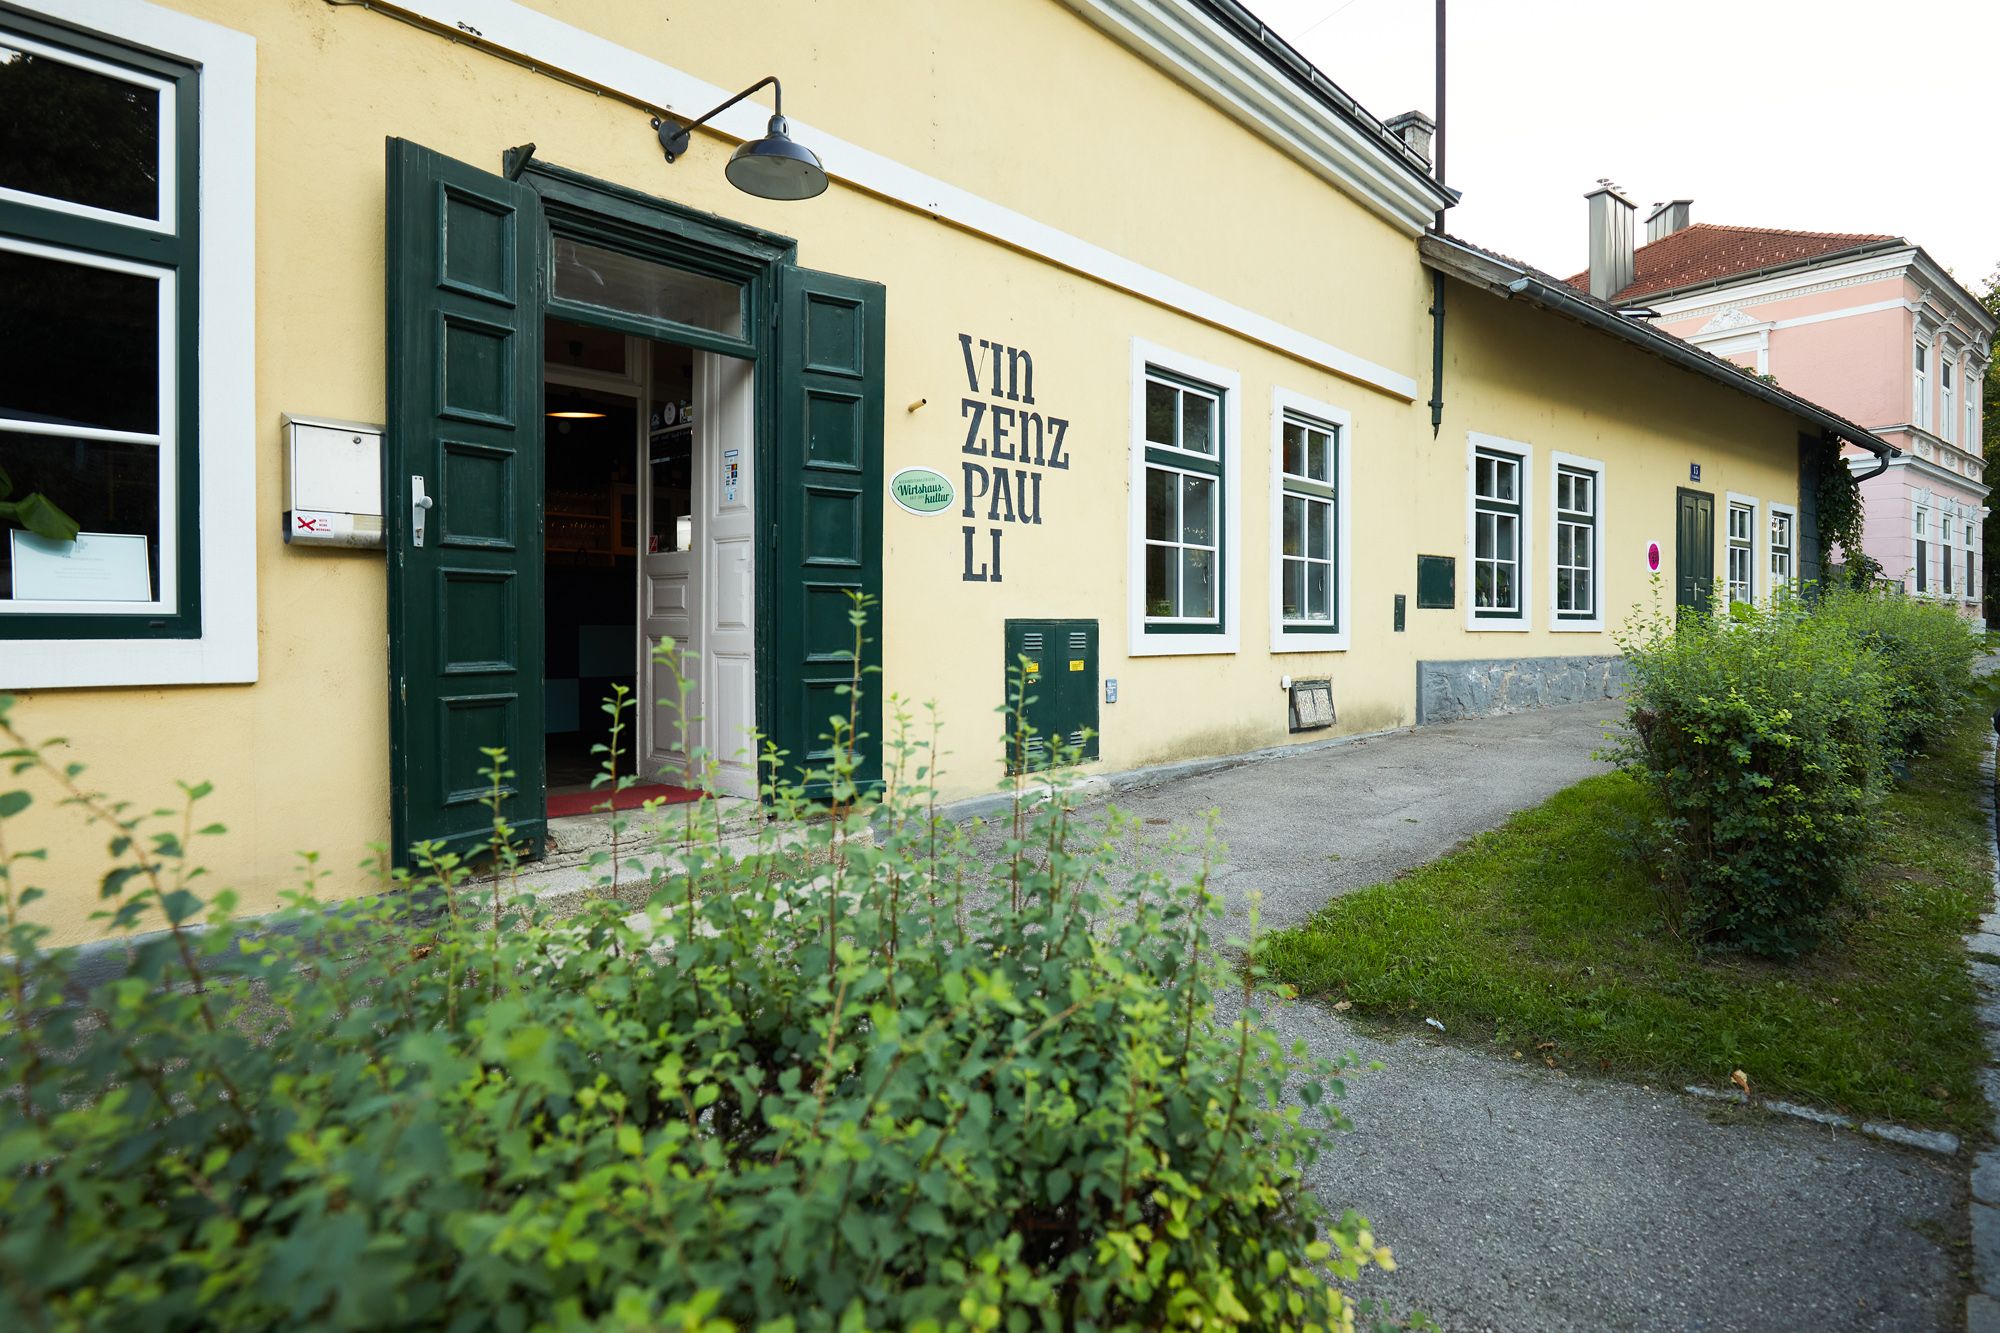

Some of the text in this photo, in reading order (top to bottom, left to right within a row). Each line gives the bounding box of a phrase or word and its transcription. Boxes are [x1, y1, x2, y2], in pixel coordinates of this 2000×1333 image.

[898, 483, 944, 496] Wirtshaus-
[924, 492, 949, 504] kultur
[961, 462, 1042, 525] PAU
[962, 526, 1003, 583] LI
